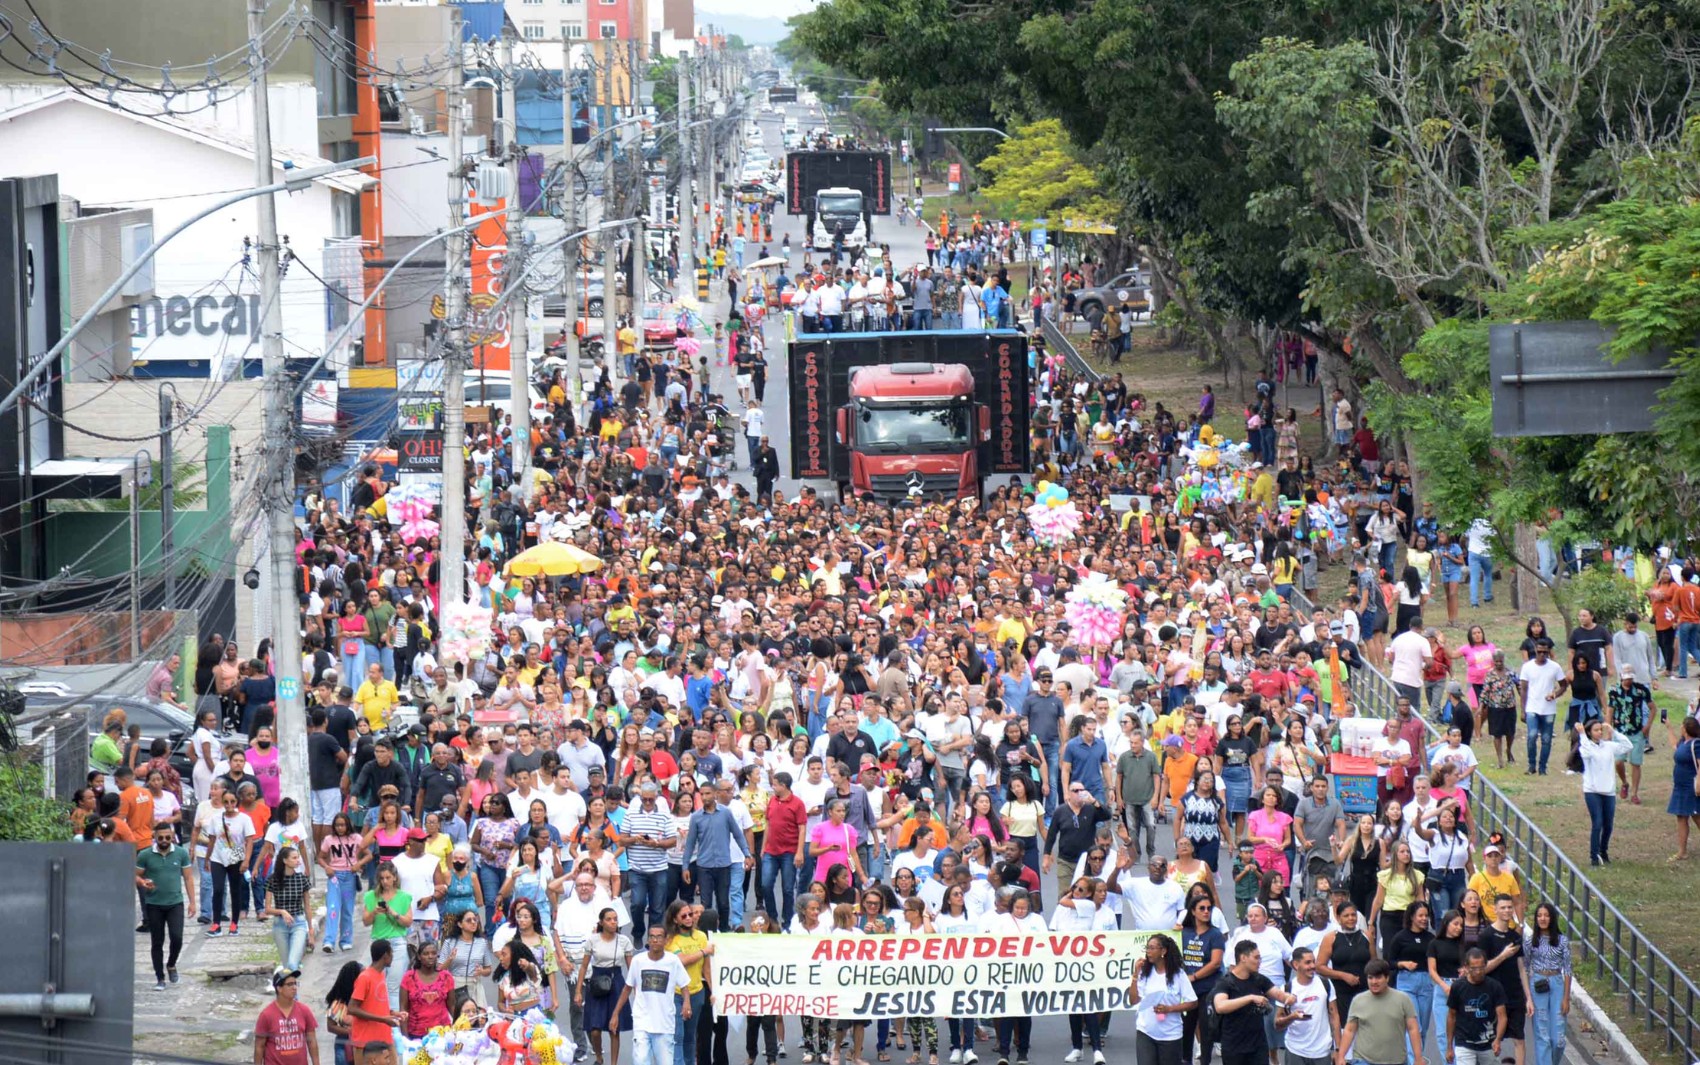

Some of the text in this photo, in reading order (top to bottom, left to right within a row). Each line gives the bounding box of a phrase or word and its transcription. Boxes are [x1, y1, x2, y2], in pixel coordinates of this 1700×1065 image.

[805, 352, 820, 470] COMENDADOR
[998, 343, 1014, 464] COMENDADOR
[404, 440, 442, 456] OH!
[408, 456, 439, 464] CLOSET
[811, 934, 1115, 961] ARREPENDEI-VOS,
[719, 965, 797, 987] PORQUE
[808, 961, 822, 985] É
[837, 965, 954, 986] CHEGANDO
[964, 964, 978, 985] O
[988, 961, 1044, 985] REINO
[1055, 962, 1095, 983] DOS
[723, 985, 1132, 1016] PREPARA-SE JESUS ESTÁ VOLTANDO
